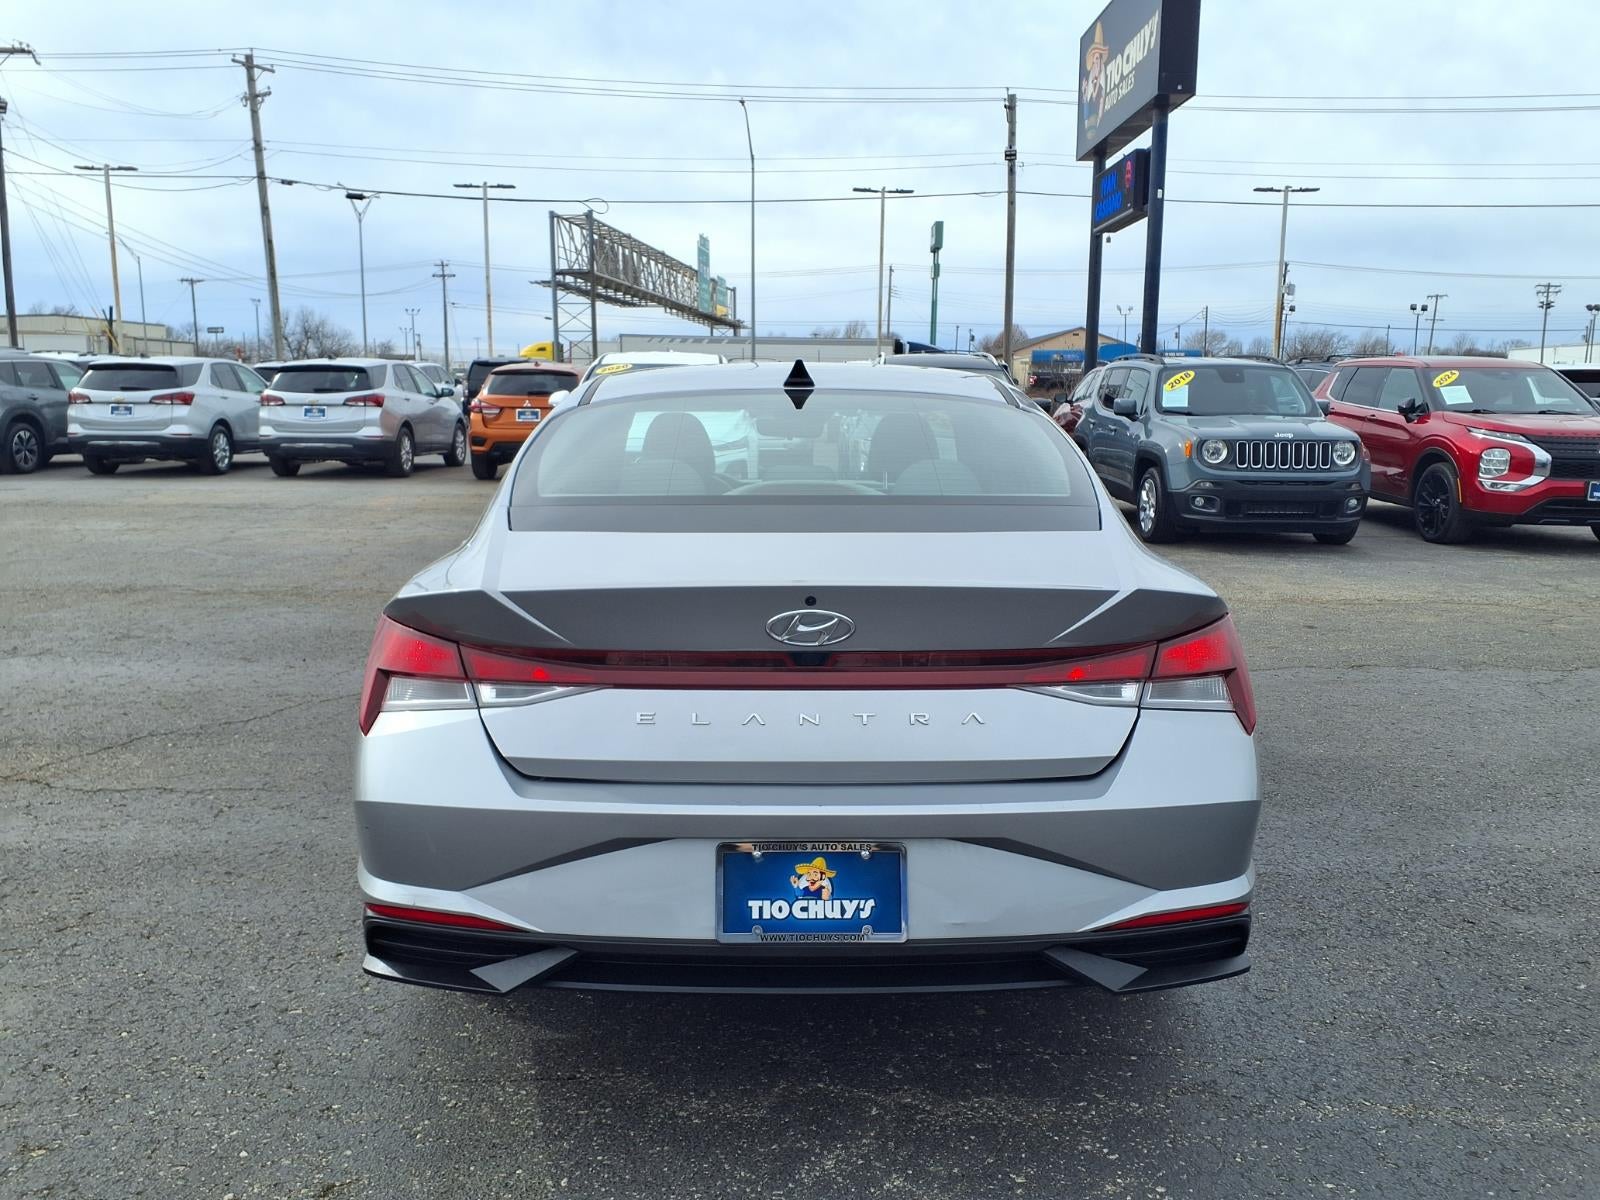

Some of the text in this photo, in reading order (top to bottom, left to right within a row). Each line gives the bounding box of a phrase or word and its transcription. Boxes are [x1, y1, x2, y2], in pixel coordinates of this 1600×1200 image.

[1106, 53, 1123, 94] TIO
[1104, 70, 1135, 112] AUTO SALES
[1435, 371, 1457, 386] 2024
[636, 712, 985, 726] ELANTRA
[811, 843, 838, 851] AUTO
[840, 843, 872, 851] SALES
[760, 934, 865, 942] WWW.TIOCHUYS.COM
